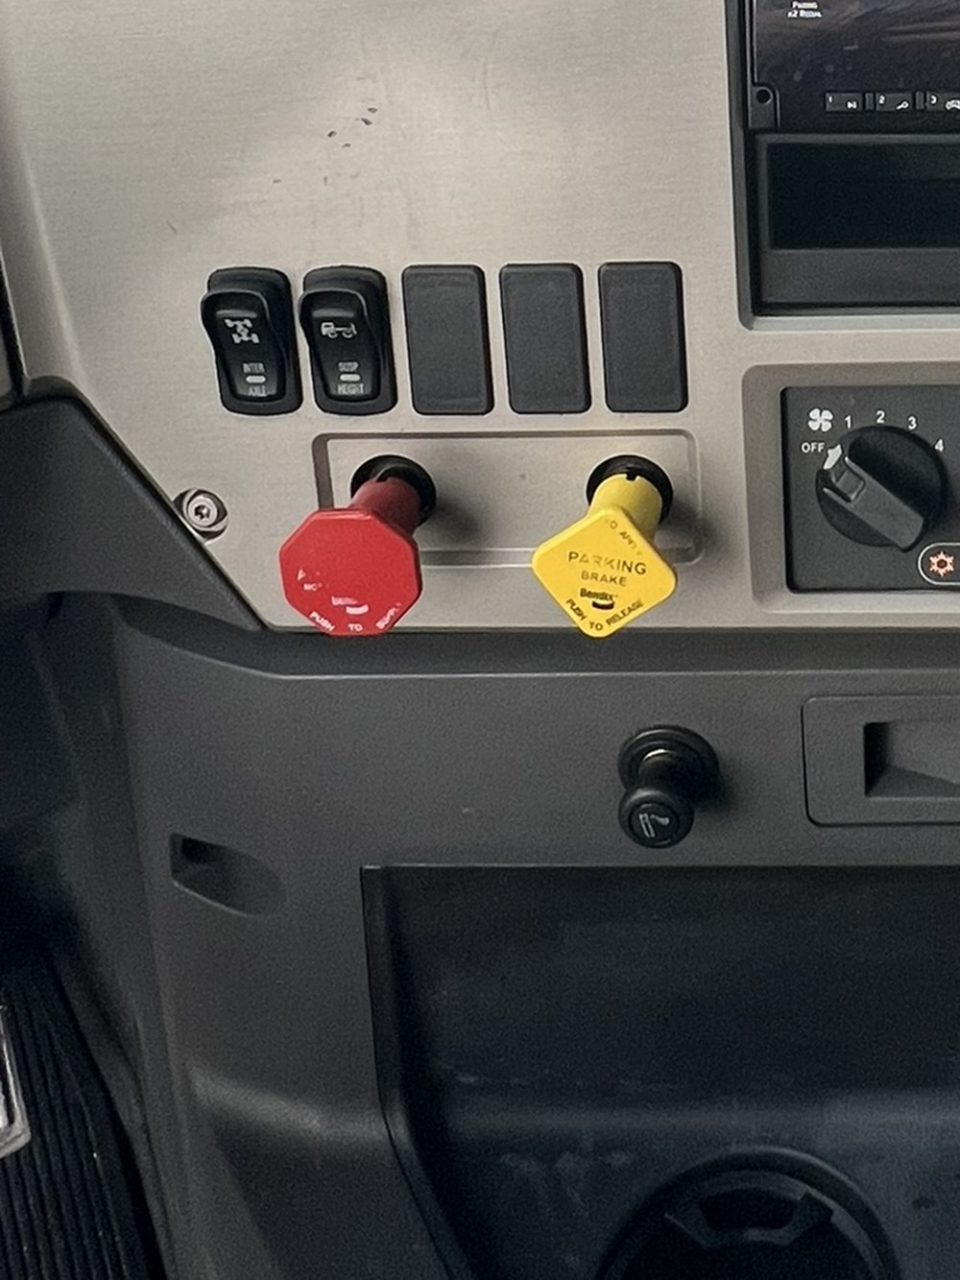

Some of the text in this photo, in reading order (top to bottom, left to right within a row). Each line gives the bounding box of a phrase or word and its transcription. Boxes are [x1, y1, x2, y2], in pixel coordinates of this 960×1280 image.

[844, 415, 851, 429] 1
[876, 410, 886, 423] 2
[908, 416, 917, 430] 3
[801, 442, 825, 454] OFF
[934, 438, 944, 452] 4
[568, 551, 647, 575] PARKING
[581, 570, 628, 587] BRAKE
[309, 611, 335, 632] PUSH
[348, 623, 363, 632] TO
[566, 598, 645, 631] PUSH TO RELEASE
